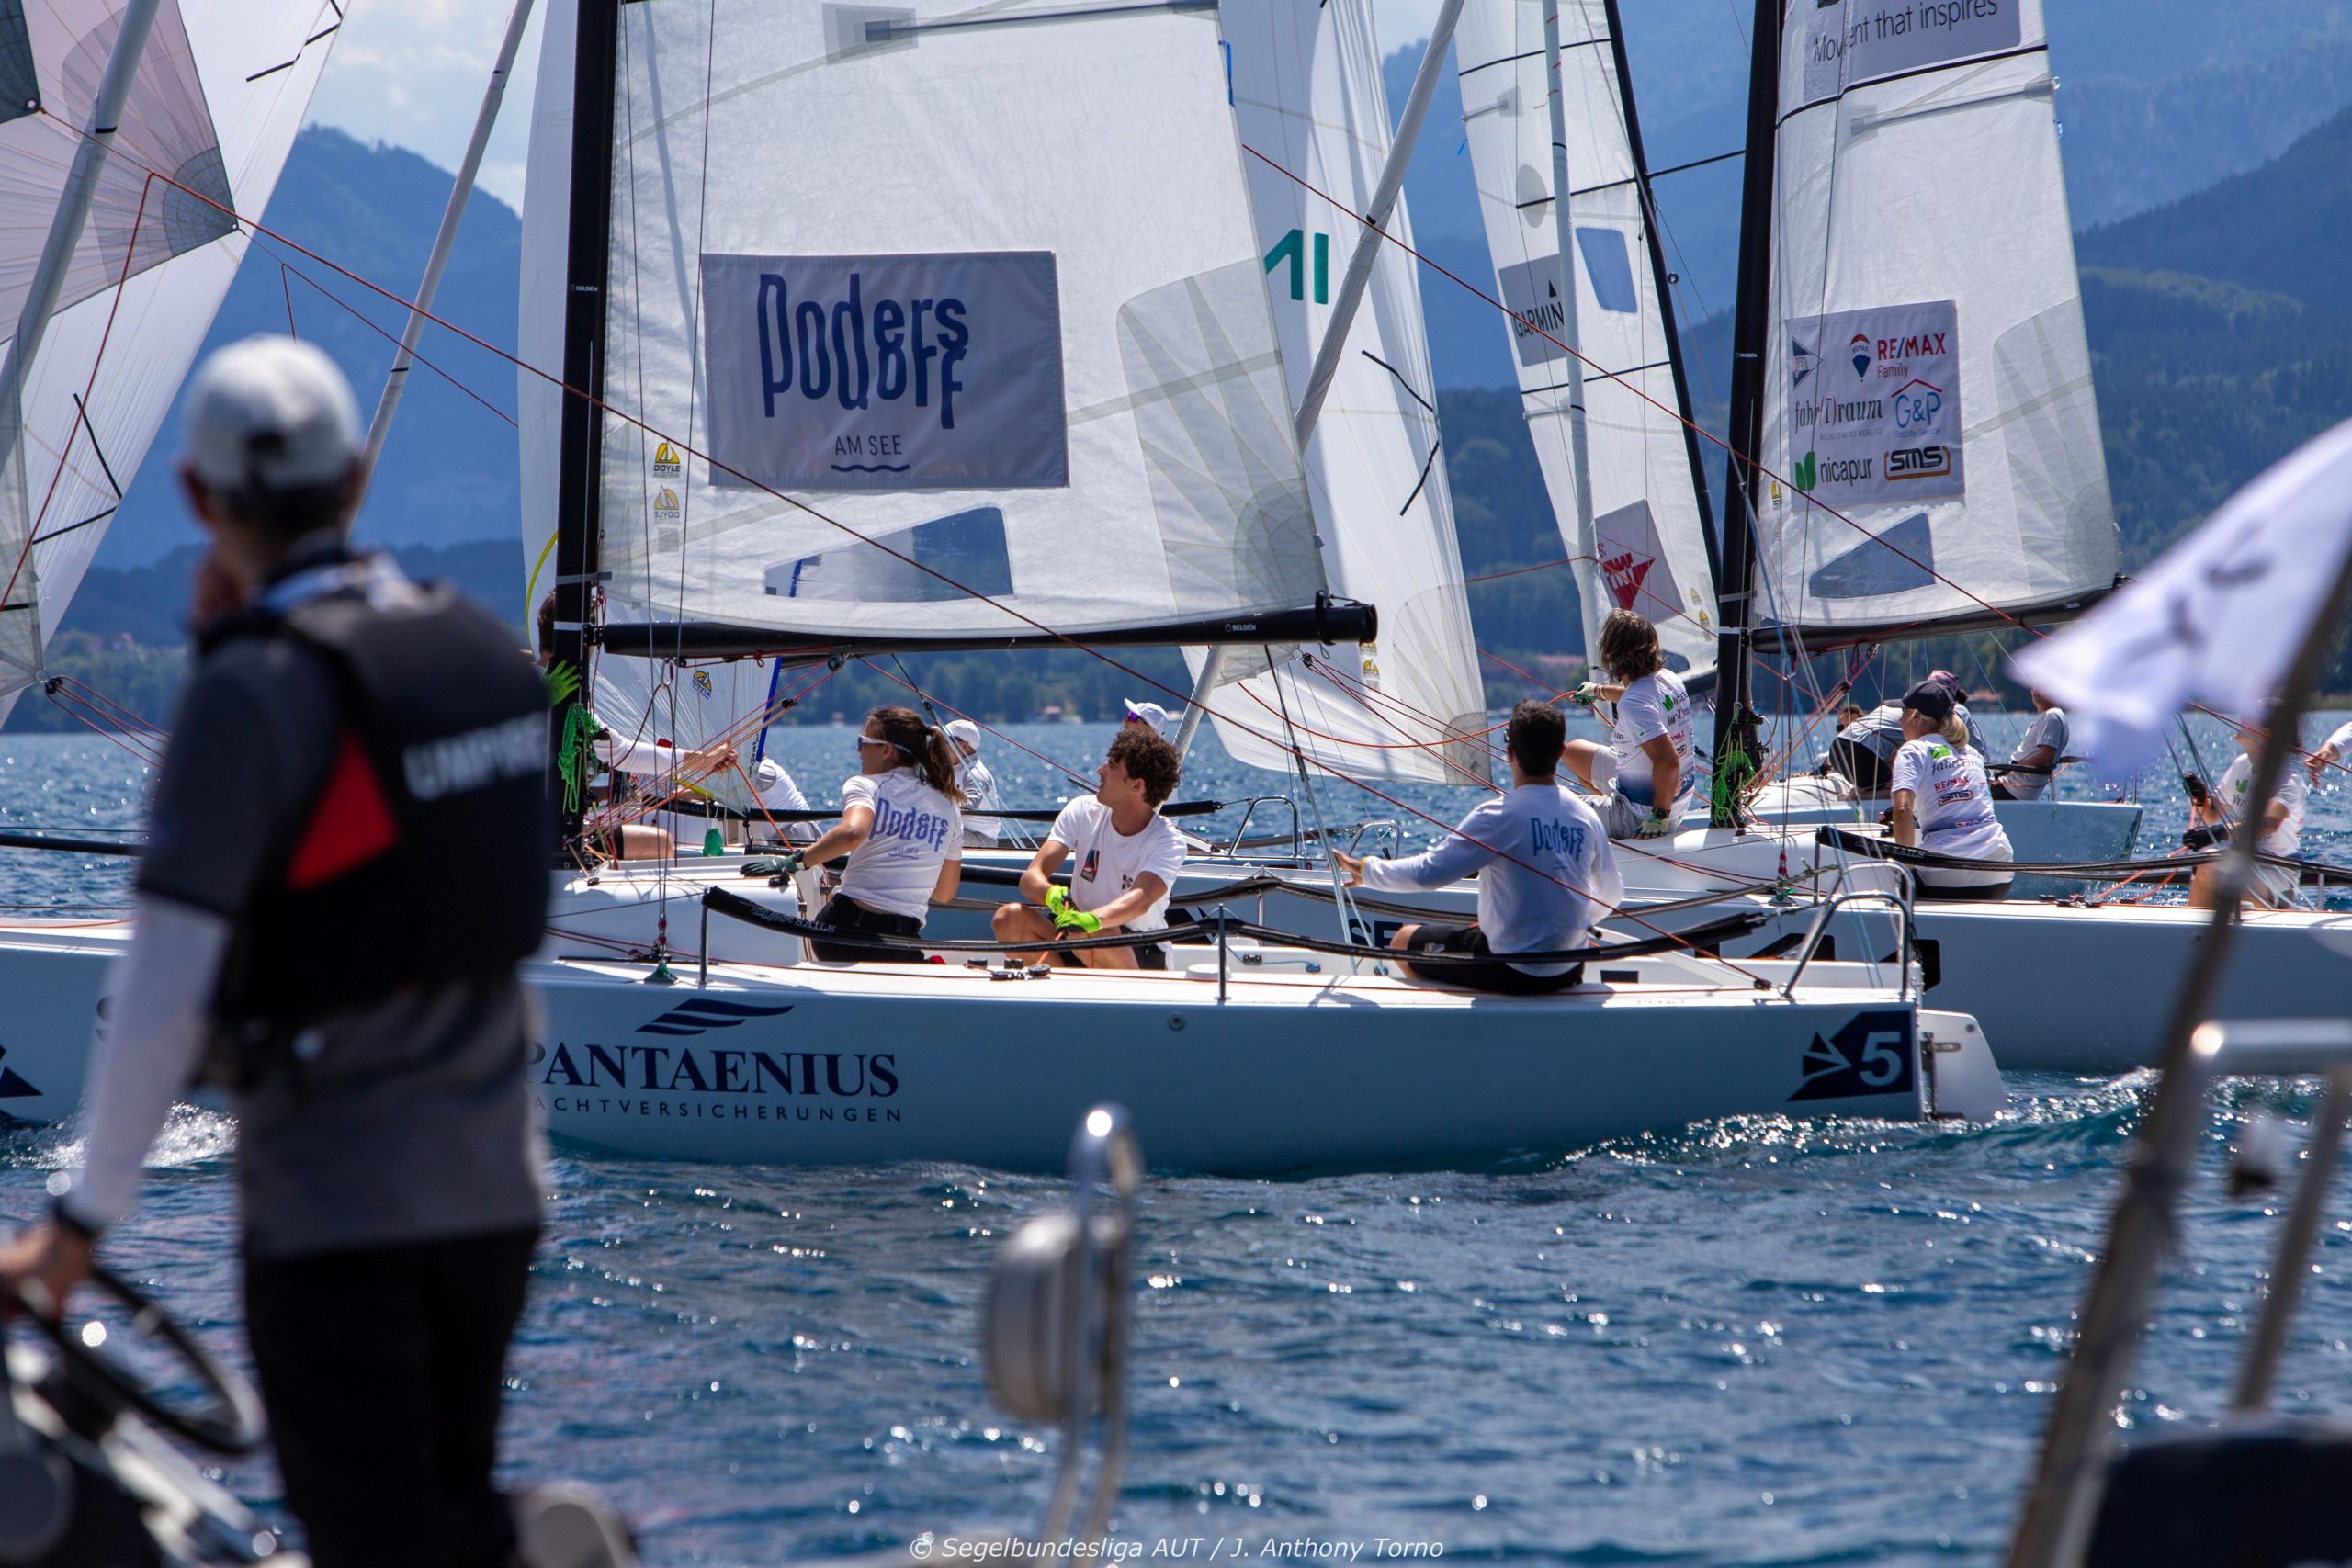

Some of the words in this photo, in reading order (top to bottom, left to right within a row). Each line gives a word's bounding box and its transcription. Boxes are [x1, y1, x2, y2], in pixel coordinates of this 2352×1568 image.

[1874, 6, 1913, 39] that
[1920, 0, 1997, 31] inspires
[1513, 300, 1565, 338] GARMIN
[1877, 333, 1946, 361] RE/MAX
[1877, 364, 1909, 380] Family
[1894, 392, 1941, 429] G&P
[834, 435, 863, 456] AM
[869, 434, 903, 456] SEE
[653, 464, 680, 472] DOYLE
[1820, 457, 1873, 486] nicapur
[1859, 1031, 1903, 1087] 5
[535, 1096, 901, 1122] ACHTVERSICHERUNGEN
